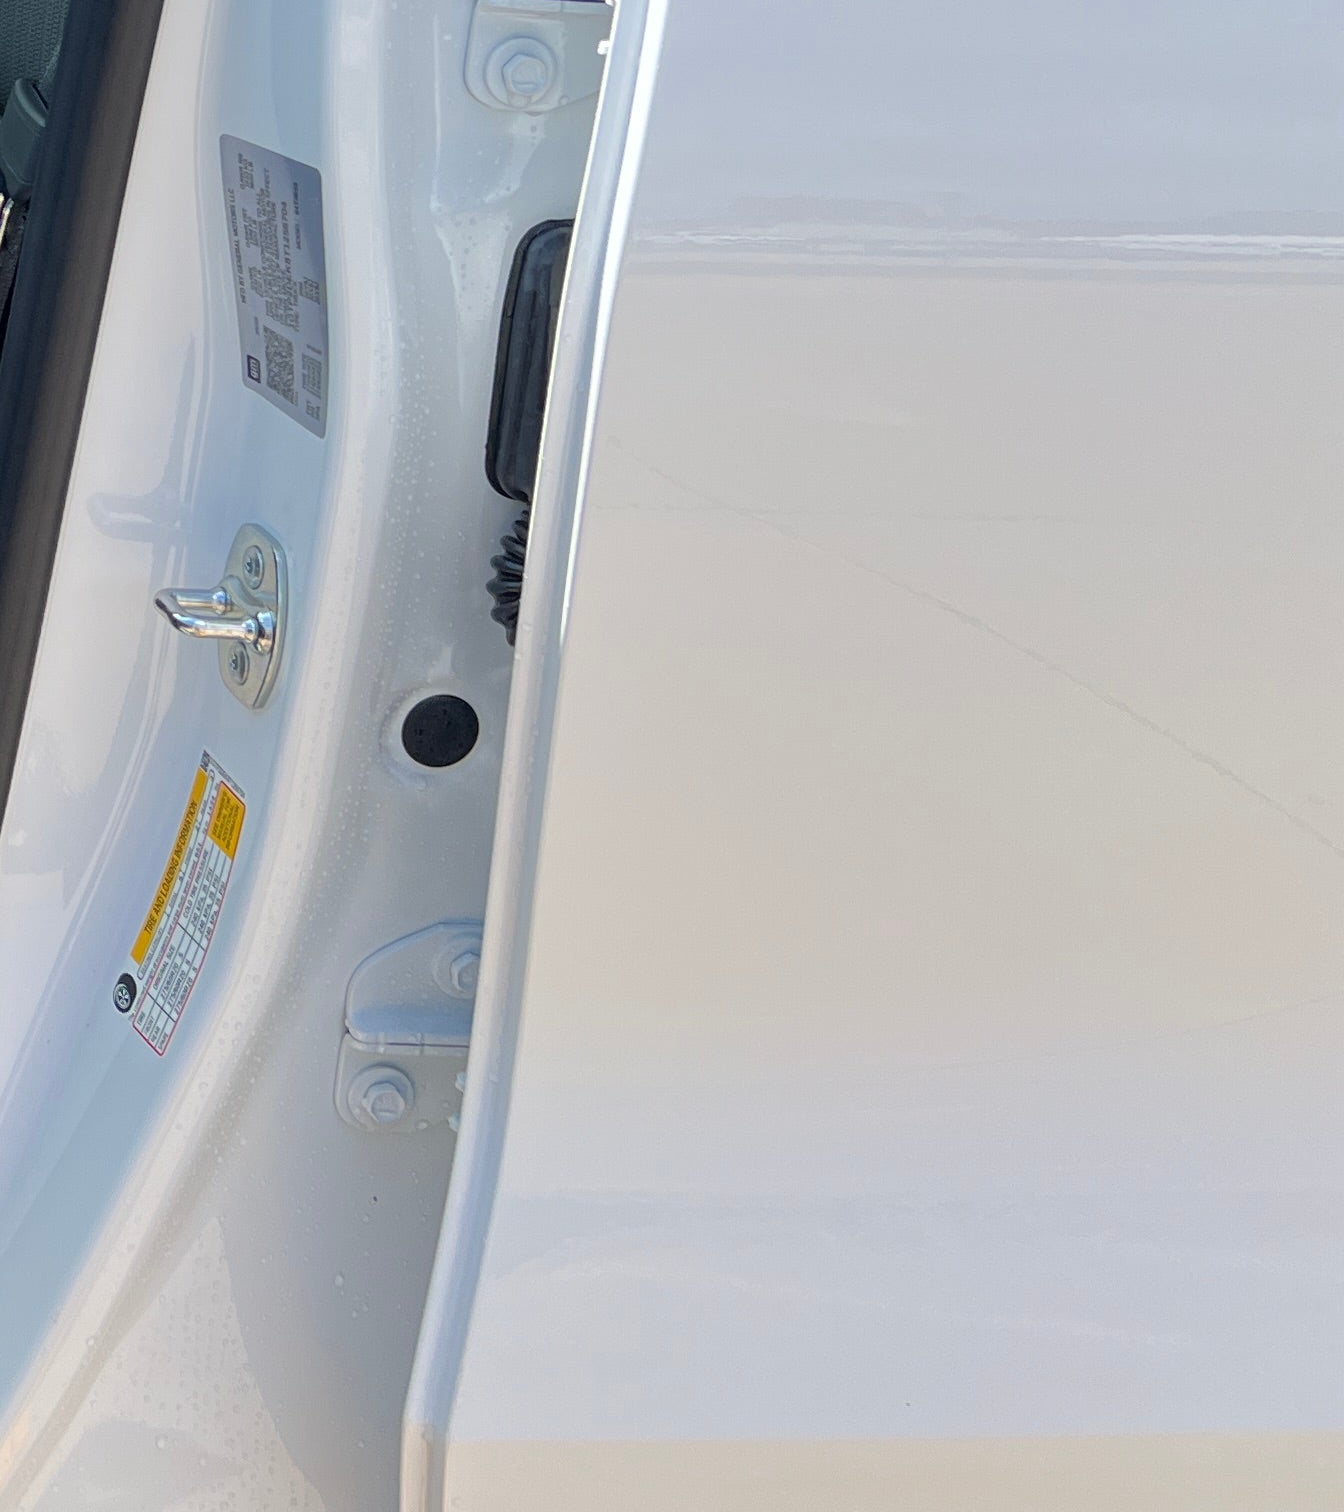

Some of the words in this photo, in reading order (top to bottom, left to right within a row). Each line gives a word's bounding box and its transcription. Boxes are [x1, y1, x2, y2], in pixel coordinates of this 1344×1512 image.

[143, 913, 157, 936] TIRE
[151, 893, 165, 916] AND
[160, 856, 179, 898] LOADING
[174, 798, 197, 860] INFORMATION
